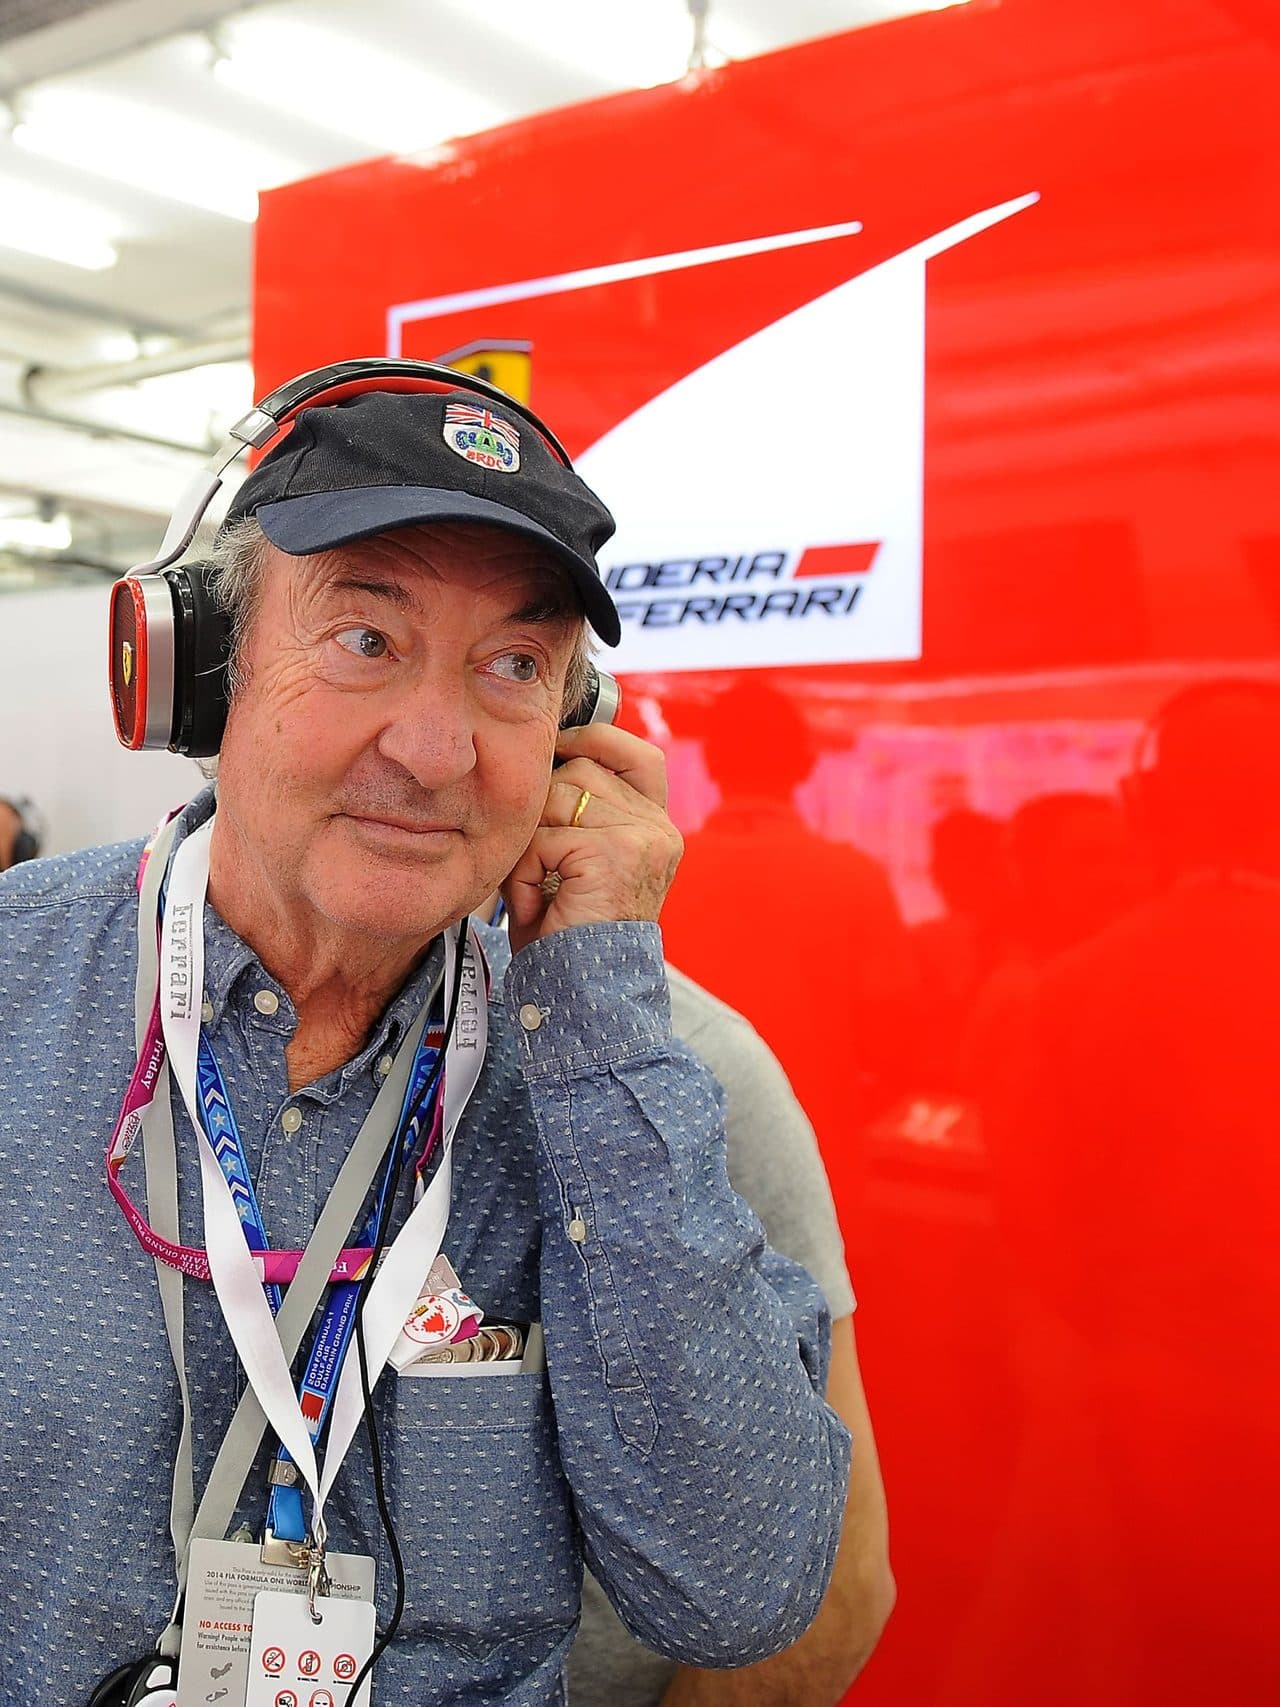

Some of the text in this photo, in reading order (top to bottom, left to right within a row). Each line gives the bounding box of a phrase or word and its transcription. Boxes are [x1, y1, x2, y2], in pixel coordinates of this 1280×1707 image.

[465, 449, 504, 469] BRDC
[616, 584, 863, 627] FERRARI
[170, 902, 194, 1020] Ferrari
[454, 938, 478, 1050] Ferrar
[141, 1039, 164, 1089] Friday
[131, 1214, 209, 1266] RAIN GRAND PRIX
[315, 1318, 333, 1362] FORMULA
[333, 1315, 348, 1347] GRAND
[343, 1293, 354, 1315] PRIX
[314, 1345, 331, 1388] GULF AIR
[237, 1574, 269, 1583] FORMULA
[199, 1620, 252, 1632] NO ACCESS TO
[221, 1633, 238, 1643] People
[232, 1644, 247, 1652] before
